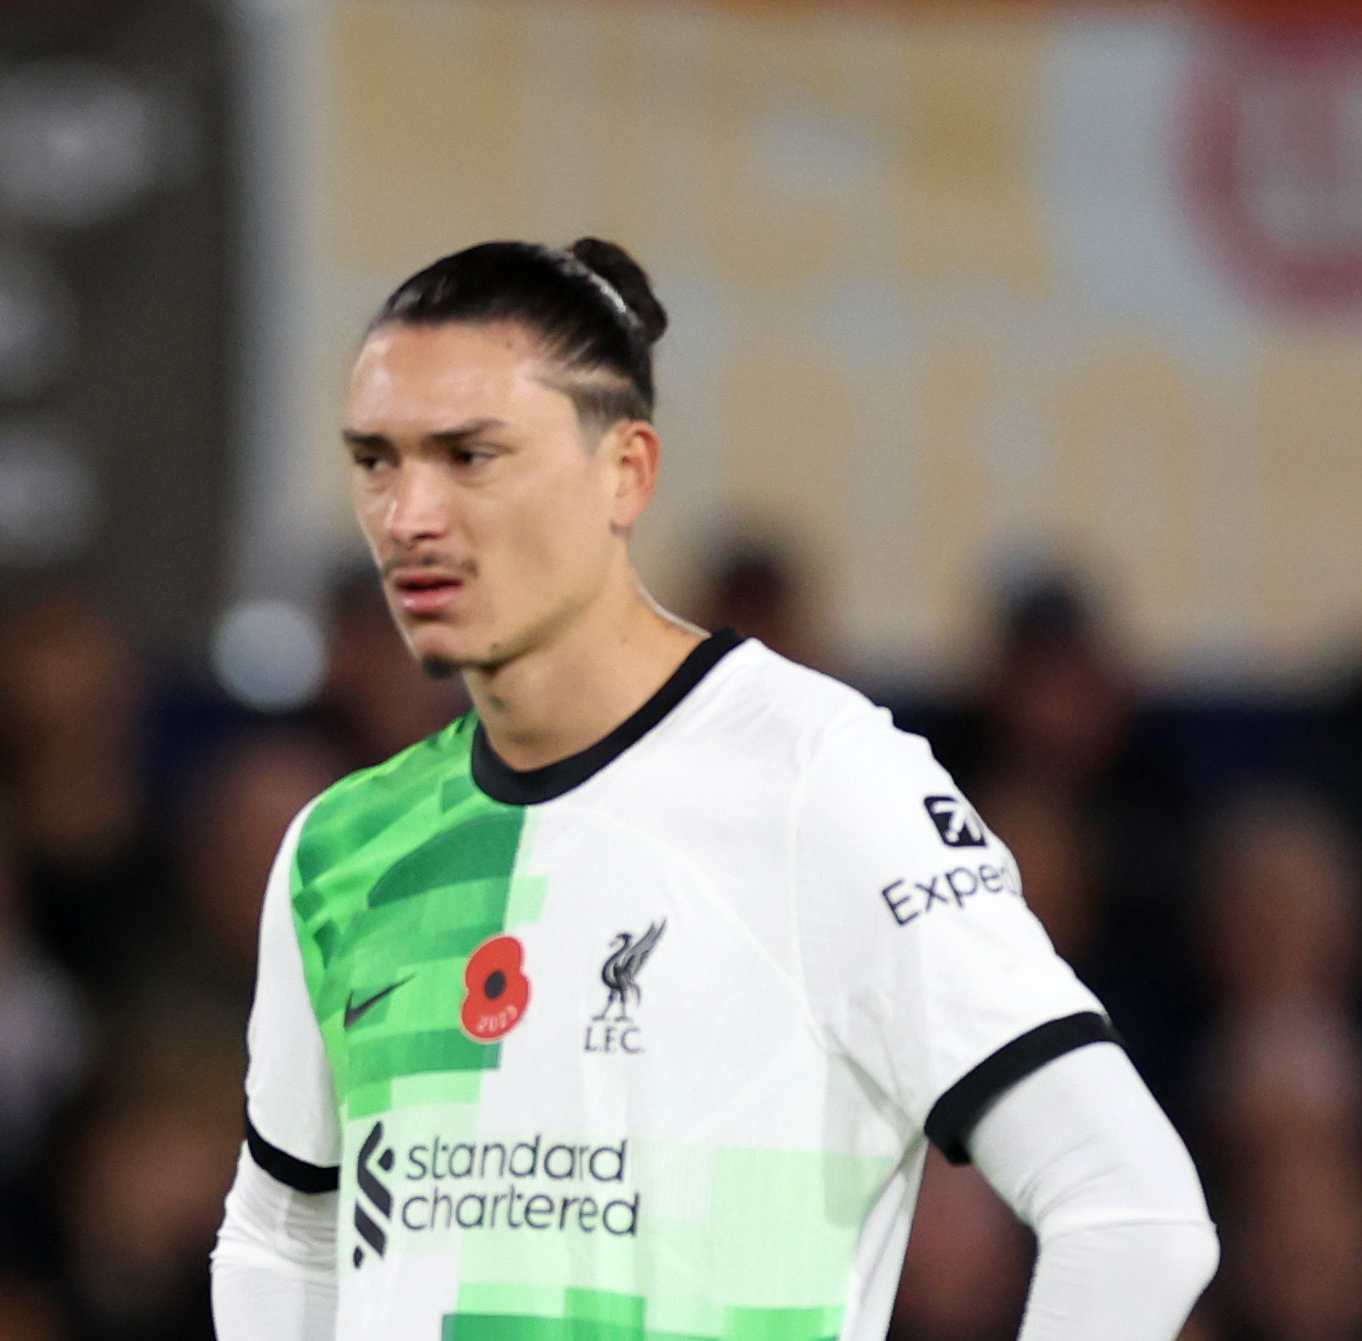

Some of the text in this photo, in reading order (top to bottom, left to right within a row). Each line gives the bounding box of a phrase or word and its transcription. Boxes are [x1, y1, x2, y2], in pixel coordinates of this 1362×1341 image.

[881, 863, 1013, 926] Expe
[405, 1133, 628, 1182] standard
[402, 1183, 640, 1237] chartered
